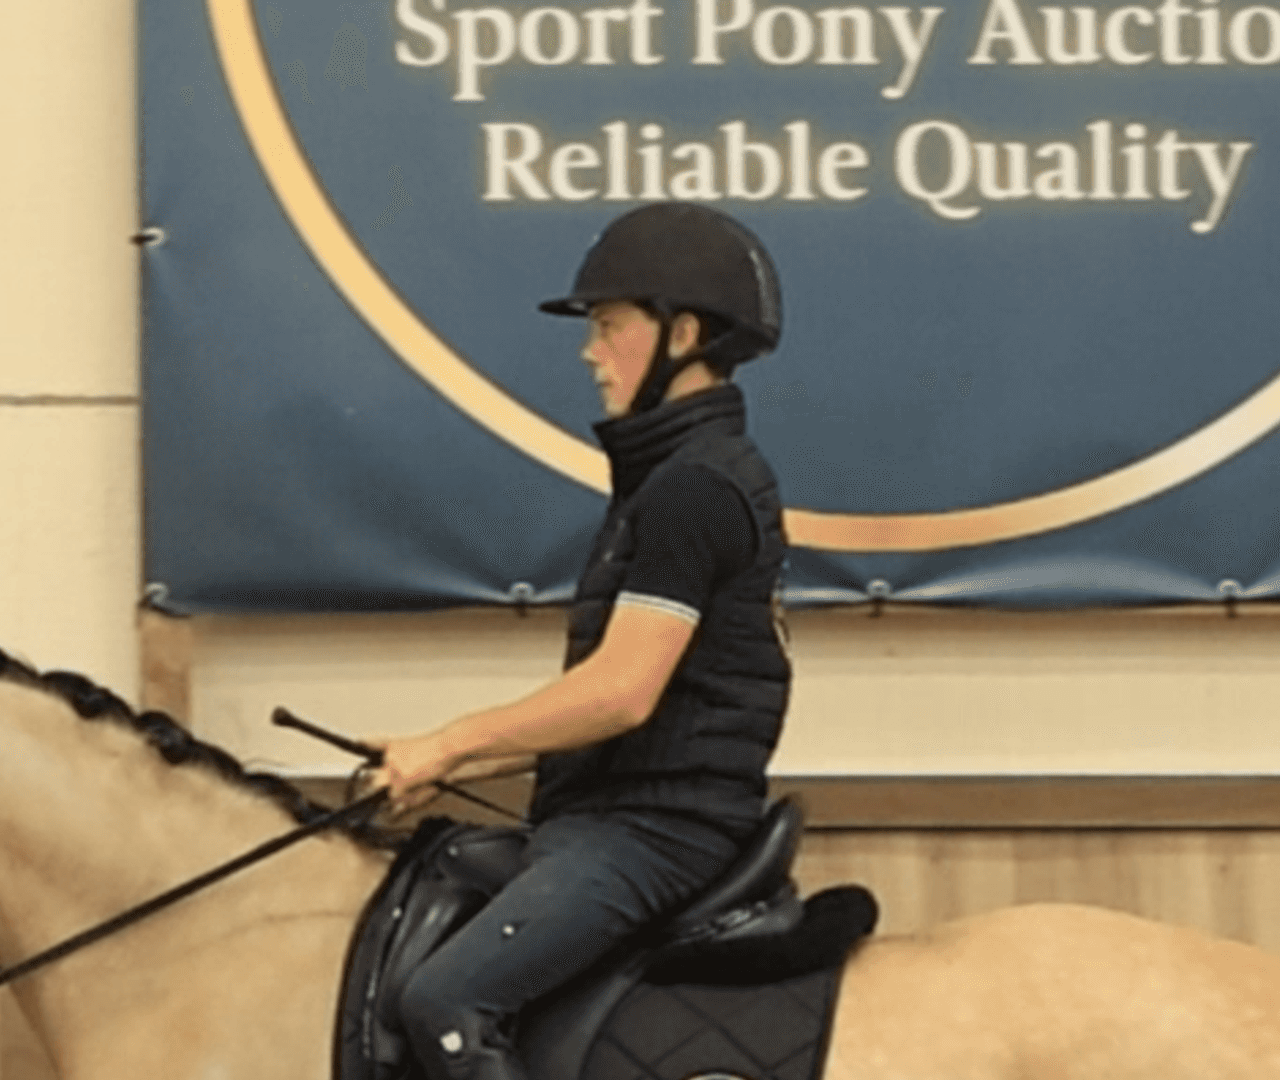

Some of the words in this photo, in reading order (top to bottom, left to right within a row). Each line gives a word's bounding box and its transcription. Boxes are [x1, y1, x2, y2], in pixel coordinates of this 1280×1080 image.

[394, 0, 665, 102] Sport
[690, 0, 944, 99] Pony
[480, 119, 870, 201] Reliable
[892, 118, 1253, 233] Quality
